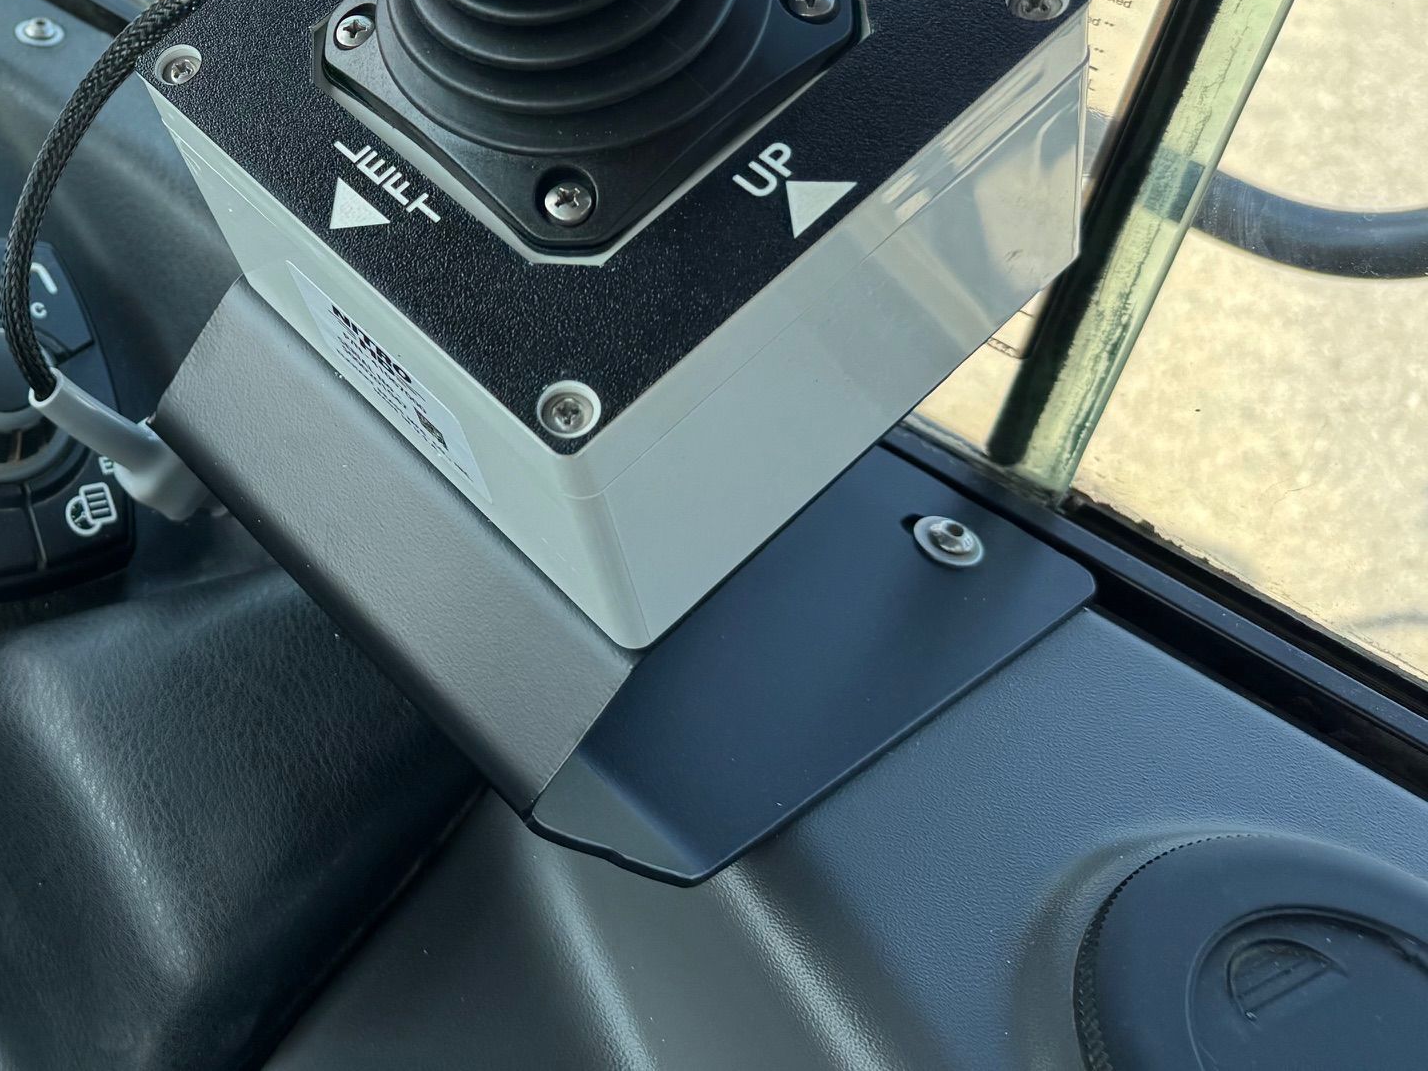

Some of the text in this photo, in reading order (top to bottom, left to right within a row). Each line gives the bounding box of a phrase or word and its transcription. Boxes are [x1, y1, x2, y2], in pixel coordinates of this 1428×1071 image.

[333, 140, 441, 223] LEFT
[732, 141, 795, 199] UP
[30, 301, 48, 319] C
[98, 456, 115, 475] E
